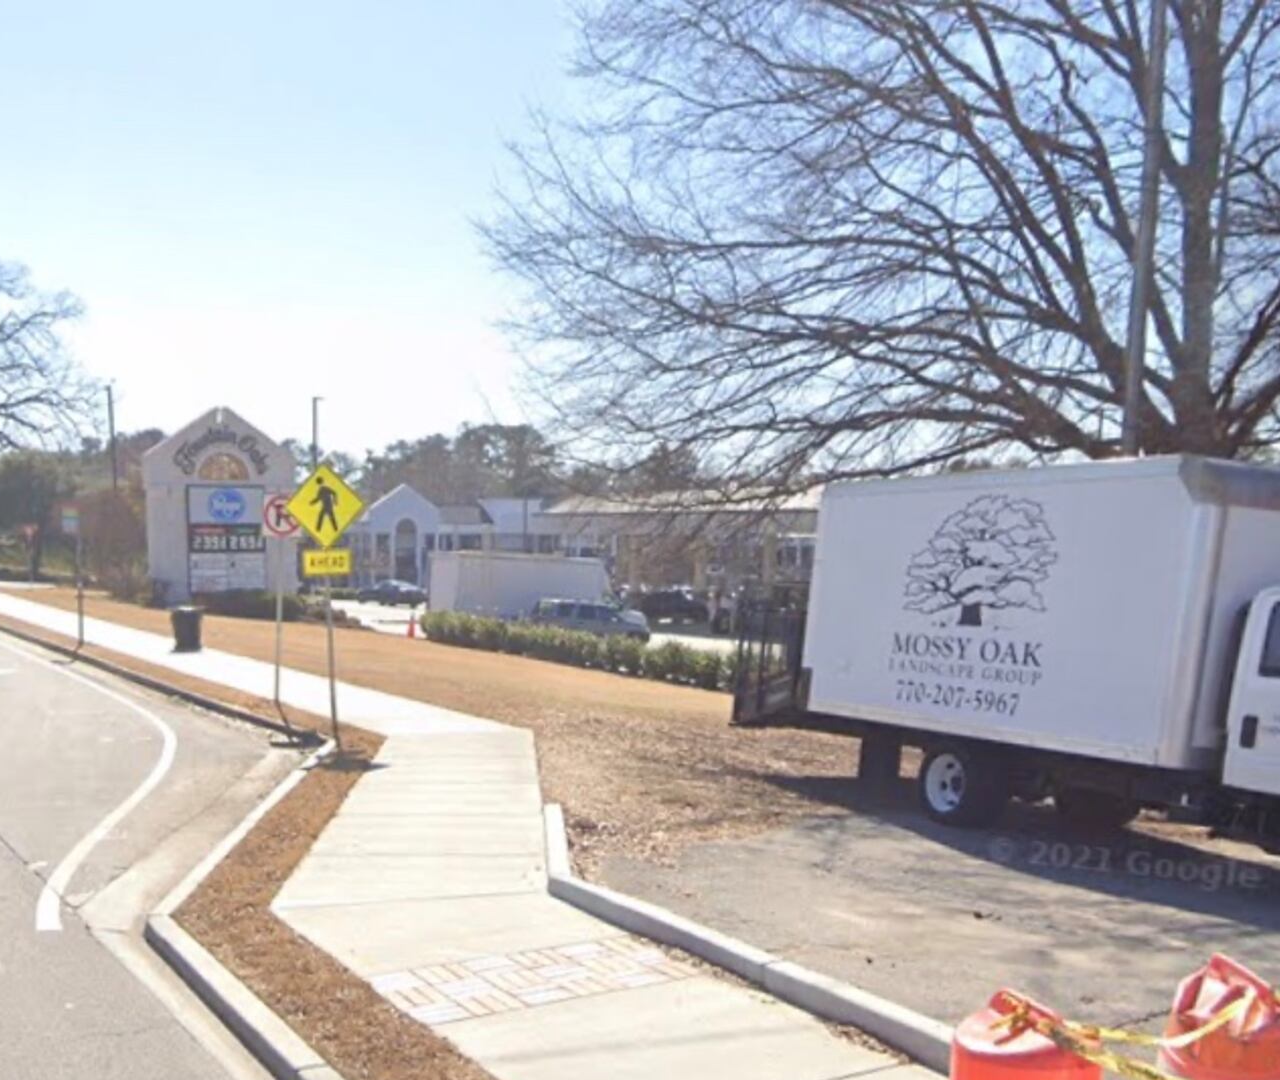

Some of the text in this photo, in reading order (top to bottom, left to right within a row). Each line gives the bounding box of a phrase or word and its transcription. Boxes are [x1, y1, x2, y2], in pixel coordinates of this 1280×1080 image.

[310, 555, 345, 568] AHEAD
[891, 631, 1043, 668] MOSSY OAK
[888, 657, 1043, 686] LANDSCAPE GROUP
[896, 680, 1021, 716] 770-207-5967
